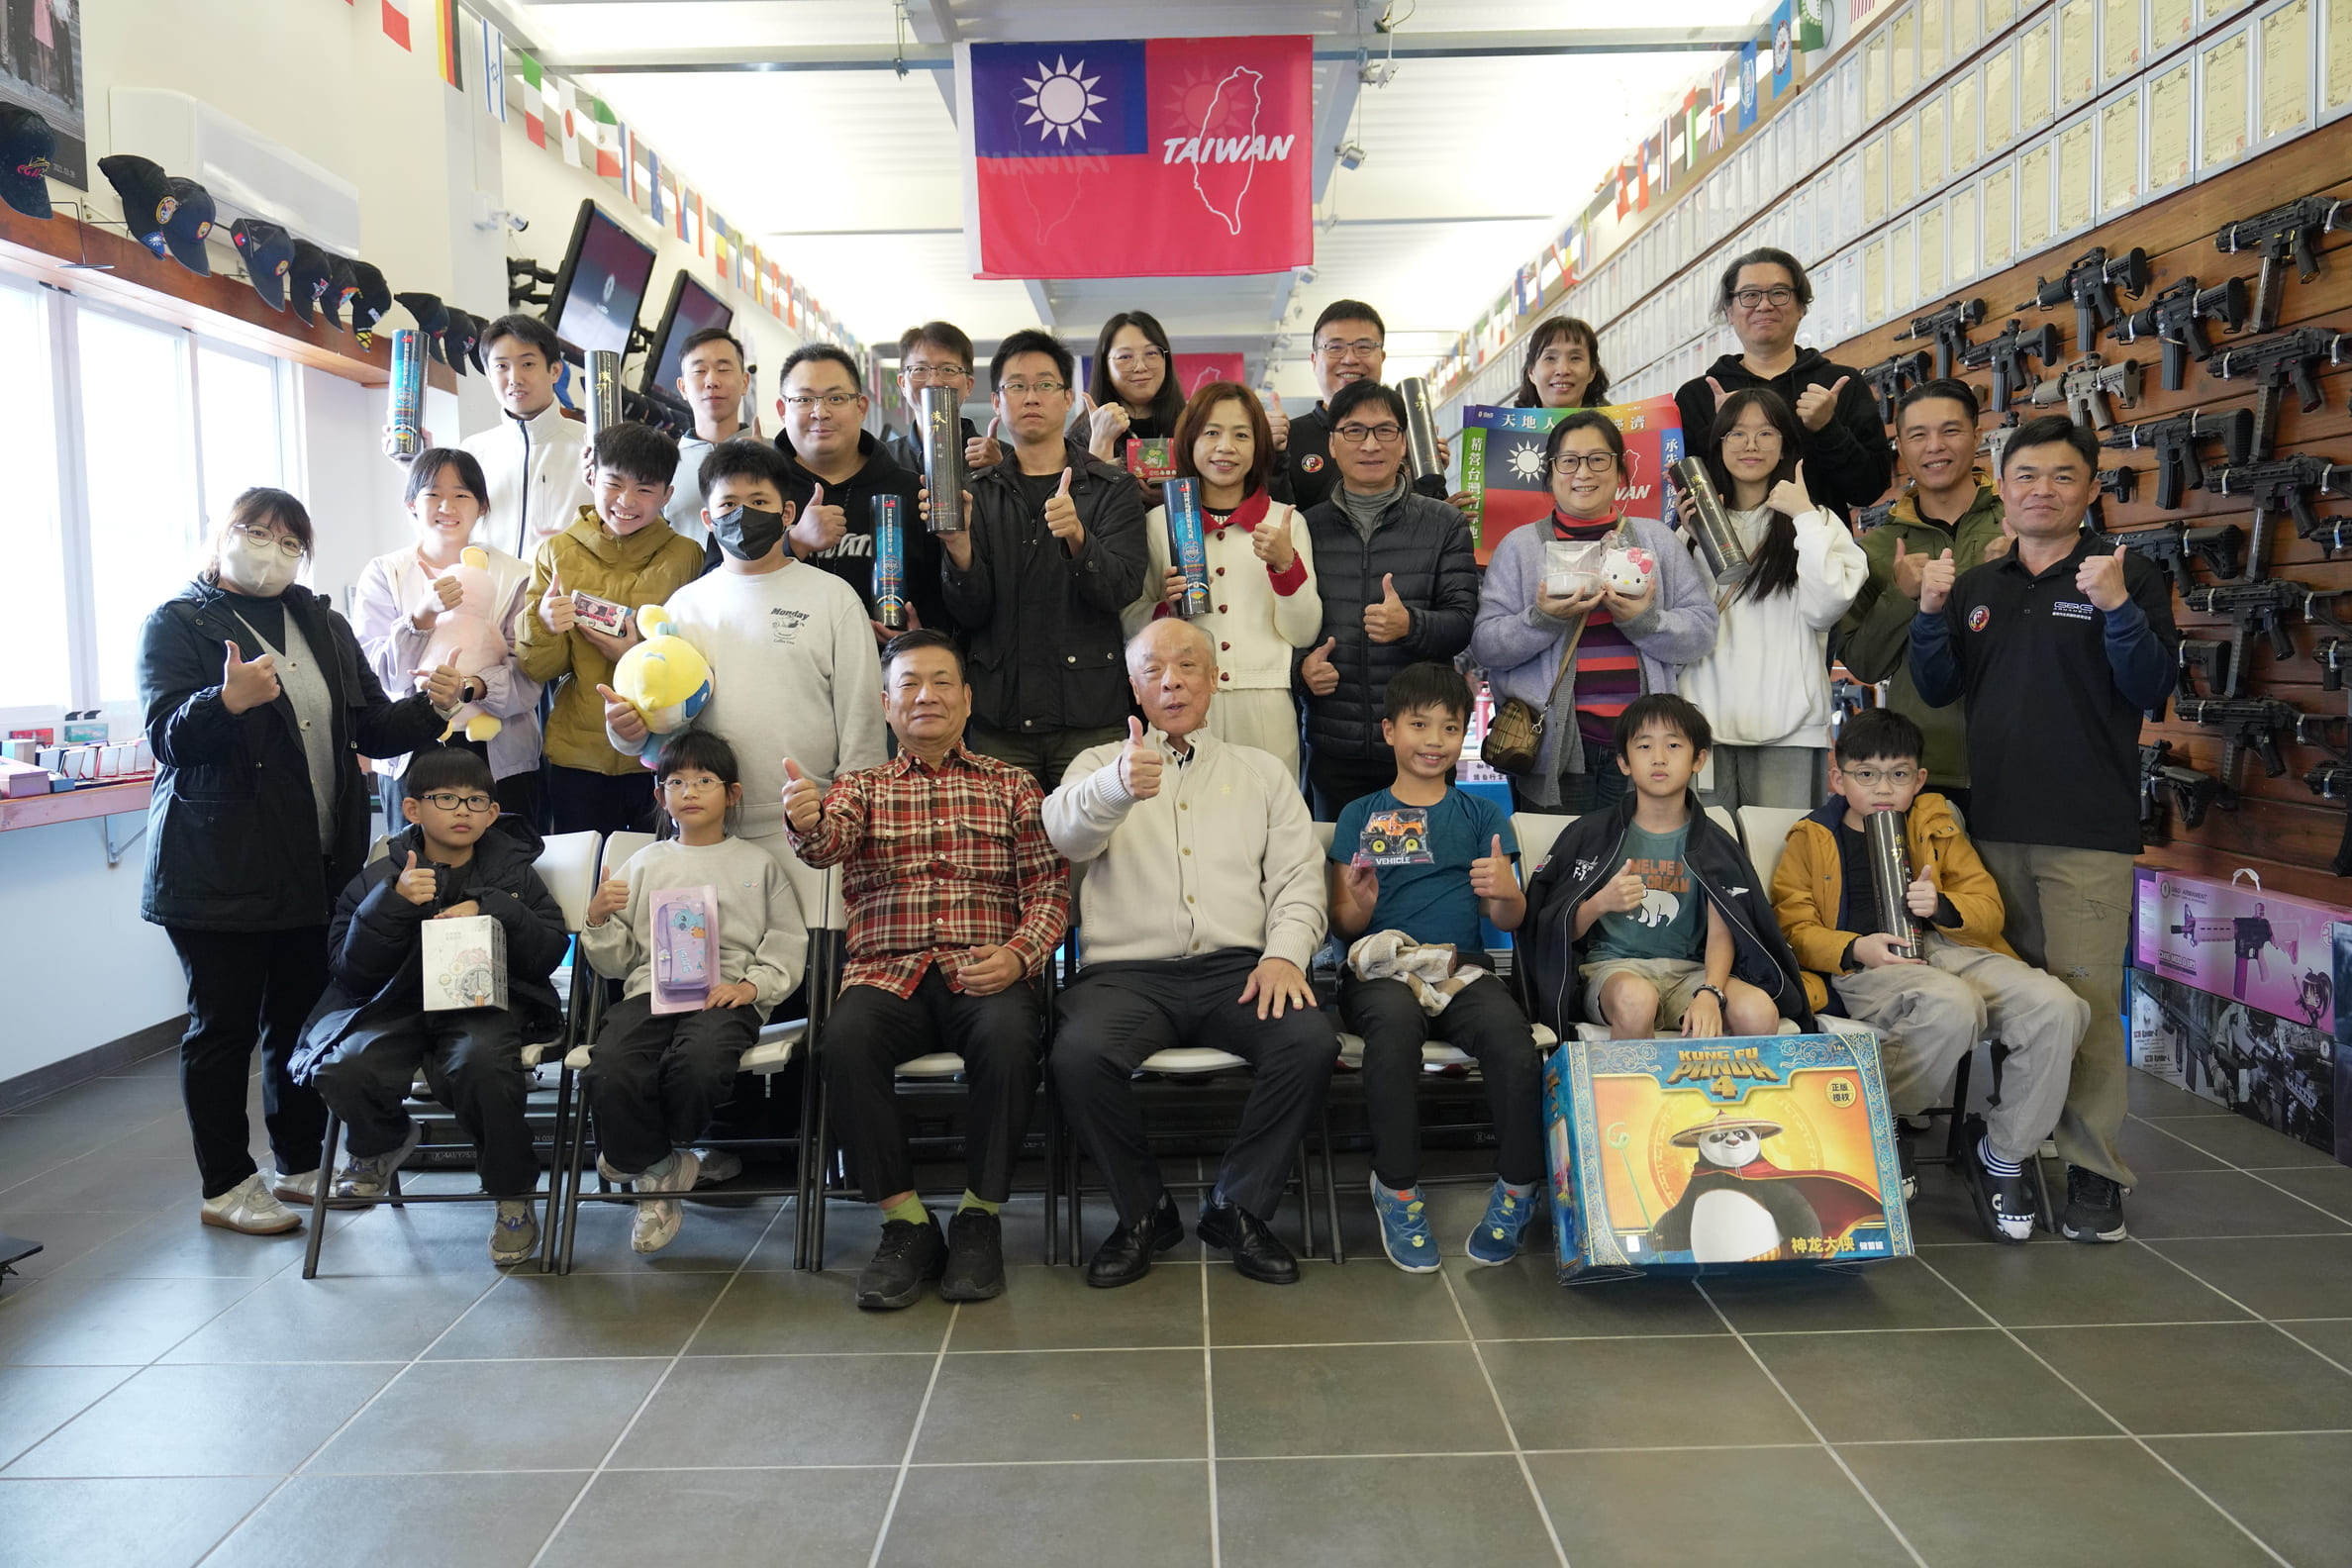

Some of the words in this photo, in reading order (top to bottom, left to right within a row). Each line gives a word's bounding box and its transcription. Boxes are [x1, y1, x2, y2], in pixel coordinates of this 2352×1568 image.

[1162, 133, 1296, 165] TAIWAN
[770, 607, 810, 621] Monday
[1375, 856, 1411, 865] VEHICLE
[1678, 1049, 1729, 1062] KUNG
[1734, 1047, 1759, 1060] FU
[1666, 1059, 1781, 1085] PANDA
[1711, 1075, 1738, 1099] 4
[1831, 1083, 1848, 1092] 正版
[1832, 1093, 1850, 1102] 授权
[1791, 1236, 1855, 1254] 神龙大侠
